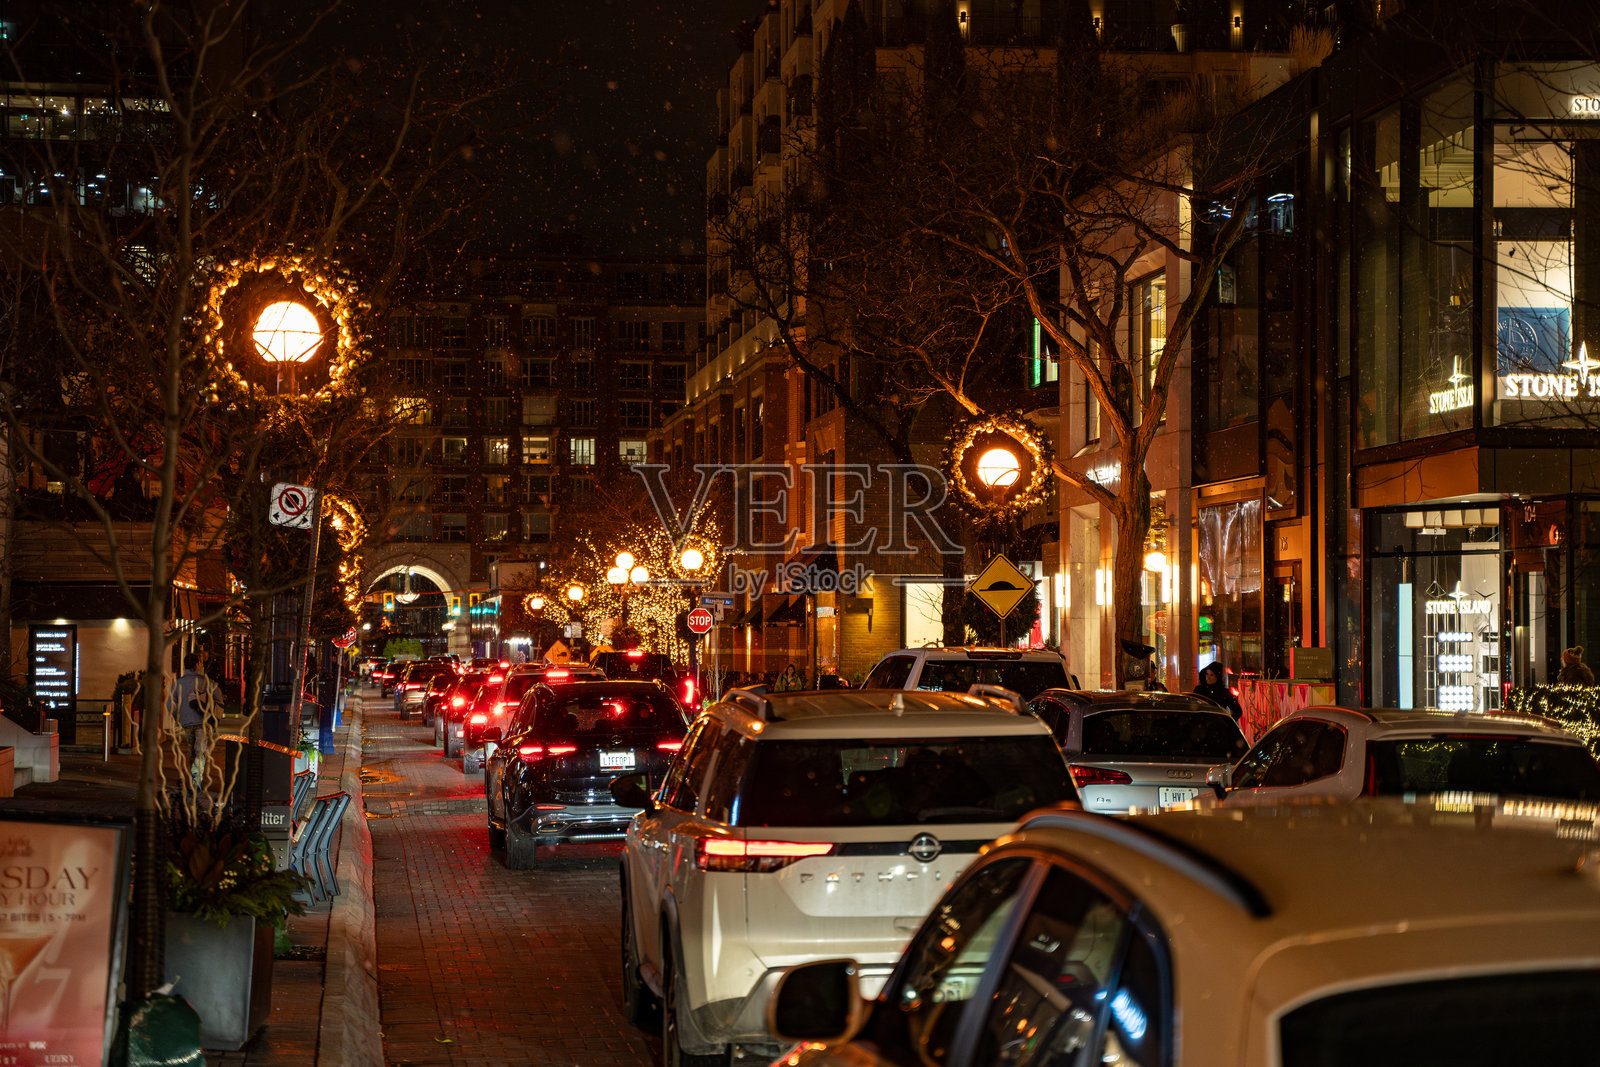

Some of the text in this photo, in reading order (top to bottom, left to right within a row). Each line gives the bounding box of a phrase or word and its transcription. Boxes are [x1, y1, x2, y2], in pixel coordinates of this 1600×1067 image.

[1505, 373, 1579, 398] STONE
[1429, 389, 1456, 414] STONE
[1523, 505, 1536, 523] 104
[1425, 600, 1492, 614] STONE ISLAND
[689, 616, 711, 626] STOP
[260, 811, 286, 825] itter
[19, 891, 76, 907] HOUR
[10, 912, 41, 922] BITES
